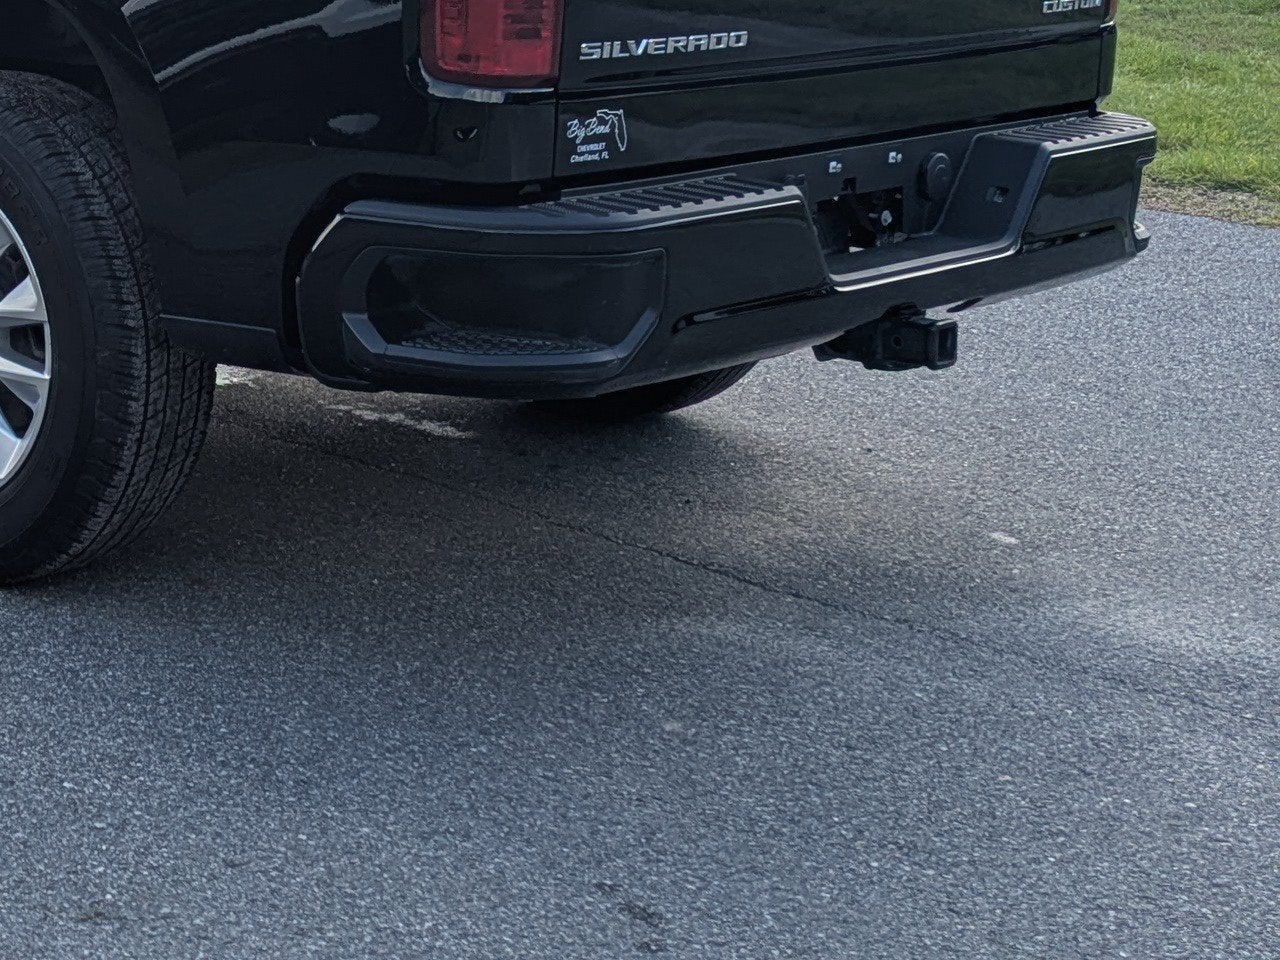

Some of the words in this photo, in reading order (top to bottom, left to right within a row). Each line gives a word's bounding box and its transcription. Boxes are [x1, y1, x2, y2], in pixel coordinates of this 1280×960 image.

[579, 31, 748, 60] SILVERADO
[566, 118, 586, 144] Big
[585, 117, 612, 136] Bend
